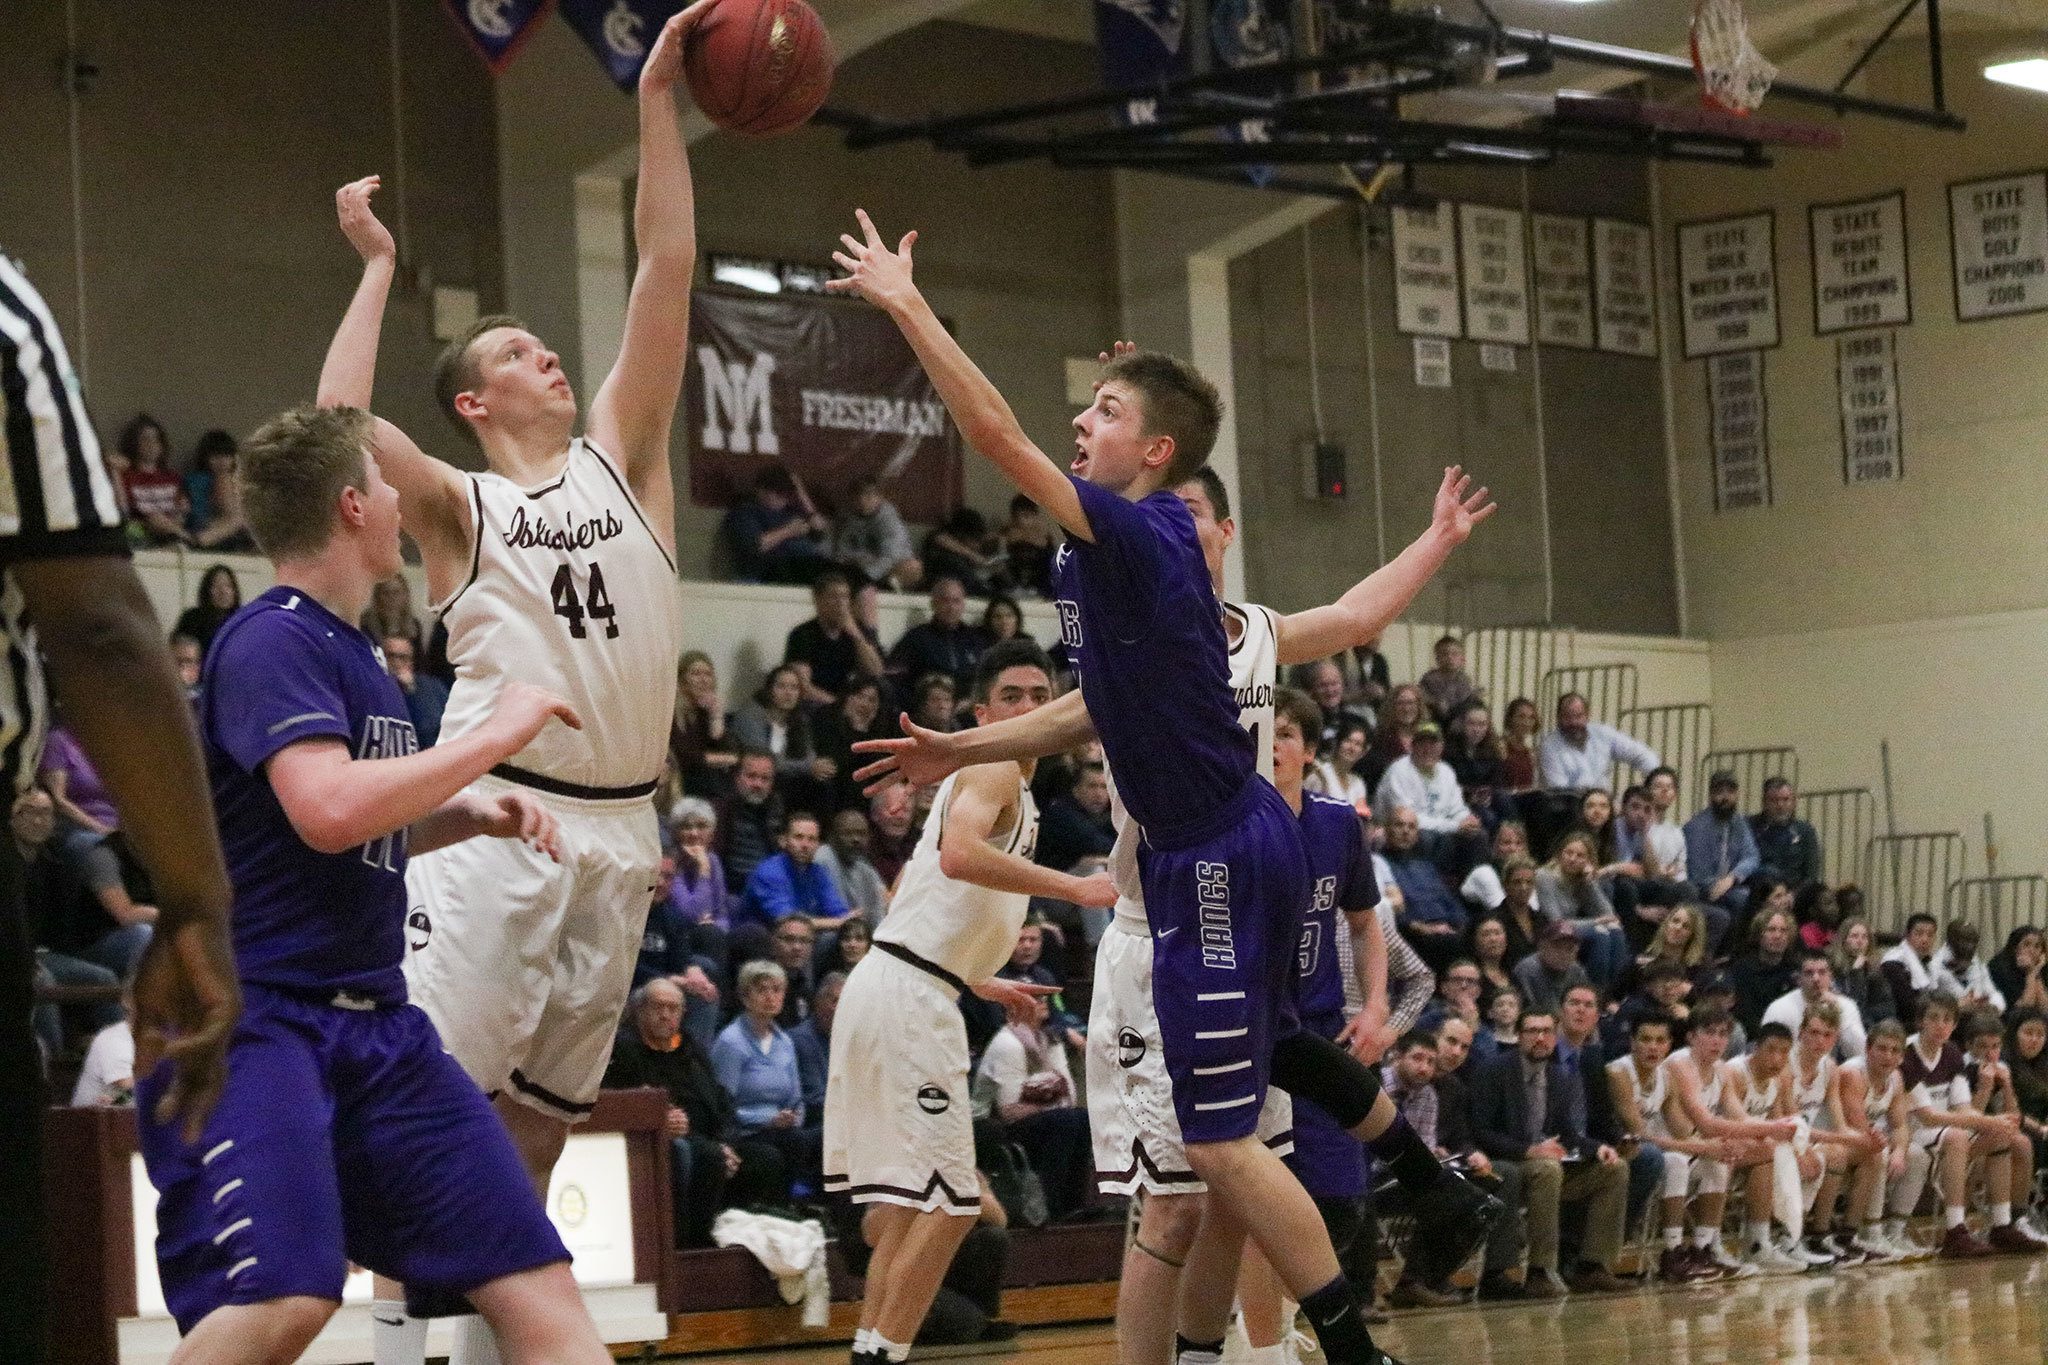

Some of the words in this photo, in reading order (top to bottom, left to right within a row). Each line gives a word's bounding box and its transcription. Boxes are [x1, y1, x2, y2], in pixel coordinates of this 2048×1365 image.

[1973, 187, 2023, 213] STATE
[1833, 208, 1880, 234] STATE
[1982, 214, 2019, 234] BOYS
[1984, 237, 2020, 258] GOLF
[1842, 258, 1879, 276] TEAM
[1964, 258, 2046, 286] CHAMPIONS
[1823, 277, 1898, 303] CHAMPIONS
[1692, 296, 1768, 320] CHAMPIONS
[801, 388, 944, 437] FRESHMAN
[550, 561, 620, 640] 44
